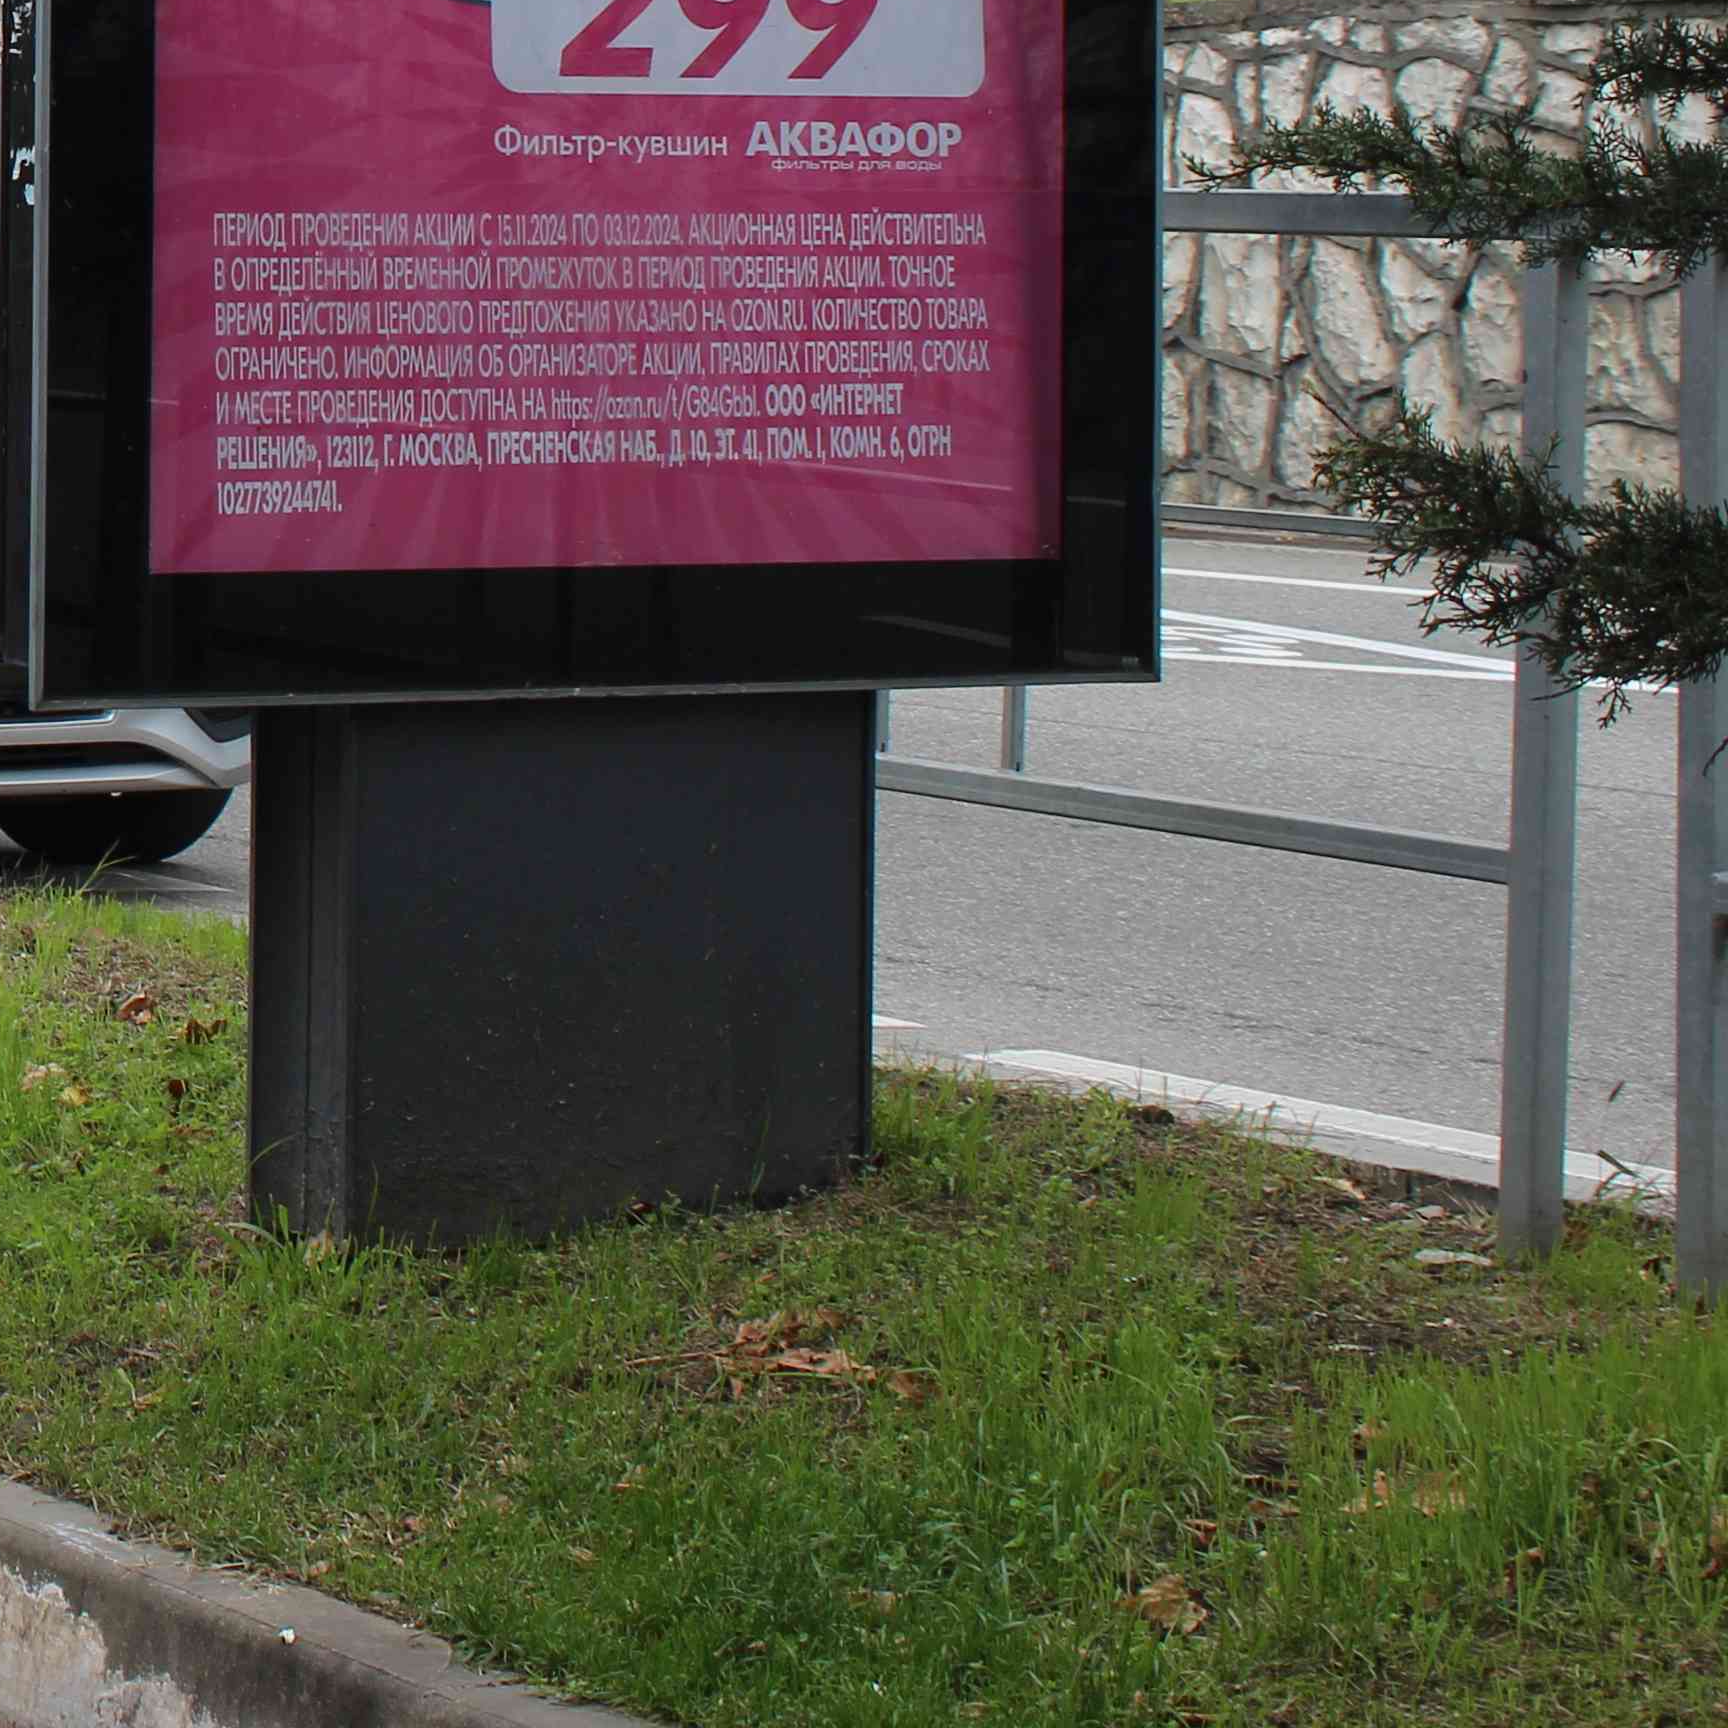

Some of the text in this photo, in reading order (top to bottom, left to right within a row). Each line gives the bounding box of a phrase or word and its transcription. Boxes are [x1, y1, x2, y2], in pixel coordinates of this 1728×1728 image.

[493, 120, 963, 162] Фильтр-кувшин АКВАФОР
[771, 158, 854, 172] фильтры
[857, 160, 892, 172] для
[214, 213, 287, 251] ПЕРИОД
[292, 213, 408, 251] ПРОВЕДЕНИЯ
[414, 214, 475, 250] АКЦИИ
[480, 214, 493, 246] С
[498, 214, 566, 246] 15.11.2024
[573, 214, 599, 246] ПО
[688, 213, 795, 250] АКЦИОННАЯ
[801, 214, 844, 251] ЦЕНА
[849, 208, 986, 251] ДЕЙСТВИТЕЛЬНА
[214, 257, 225, 290] В
[231, 252, 377, 296] ОПРЕДЕЛЁННЫЙ
[384, 251, 491, 290] ВРЕМЕННОЙ
[497, 256, 617, 289] ПРОМЕЖУТОК
[623, 256, 633, 288] В
[639, 256, 706, 294] ПЕРИОД
[711, 256, 817, 293] ПРОВЕДЕНИЯ
[889, 256, 955, 288] ТОЧНОЕ
[215, 302, 272, 335] ВРЕМЯ
[278, 297, 370, 340] ДЕЙСТВИЯ
[377, 301, 473, 339] ЦЕНОВОГО
[480, 300, 609, 338] ПРЕДЛОЖЕНИЯ
[614, 299, 696, 332] УКАЗАНО
[703, 300, 726, 332] НА
[812, 298, 920, 331] КОЛИЧЕСТВО
[925, 298, 988, 329] ТОВАРА
[216, 345, 338, 381] ОГРАНИЧЕНО.
[345, 344, 472, 383] ИНФОРМАЦИЯ
[478, 344, 503, 377] ОБ
[509, 343, 637, 377] ОРГАНИЗАТОРЕ
[711, 341, 799, 374] ПРАВИЛАХ
[922, 340, 990, 372] СРОКАХ
[216, 392, 229, 425] И
[235, 391, 291, 425] МЕСТЕ
[298, 389, 414, 427] ПРОВЕДЕНИЯ
[419, 388, 516, 427] ДОСТУПНА
[523, 388, 546, 420] НА
[765, 384, 806, 416] ООО
[810, 383, 904, 415] «ИНТЕРНЕТ
[384, 434, 395, 467] Г.
[399, 433, 482, 470] МОСКВА,
[487, 431, 615, 465] ПРЕСНЕНСКАЯ
[908, 425, 950, 456] ОГРН
